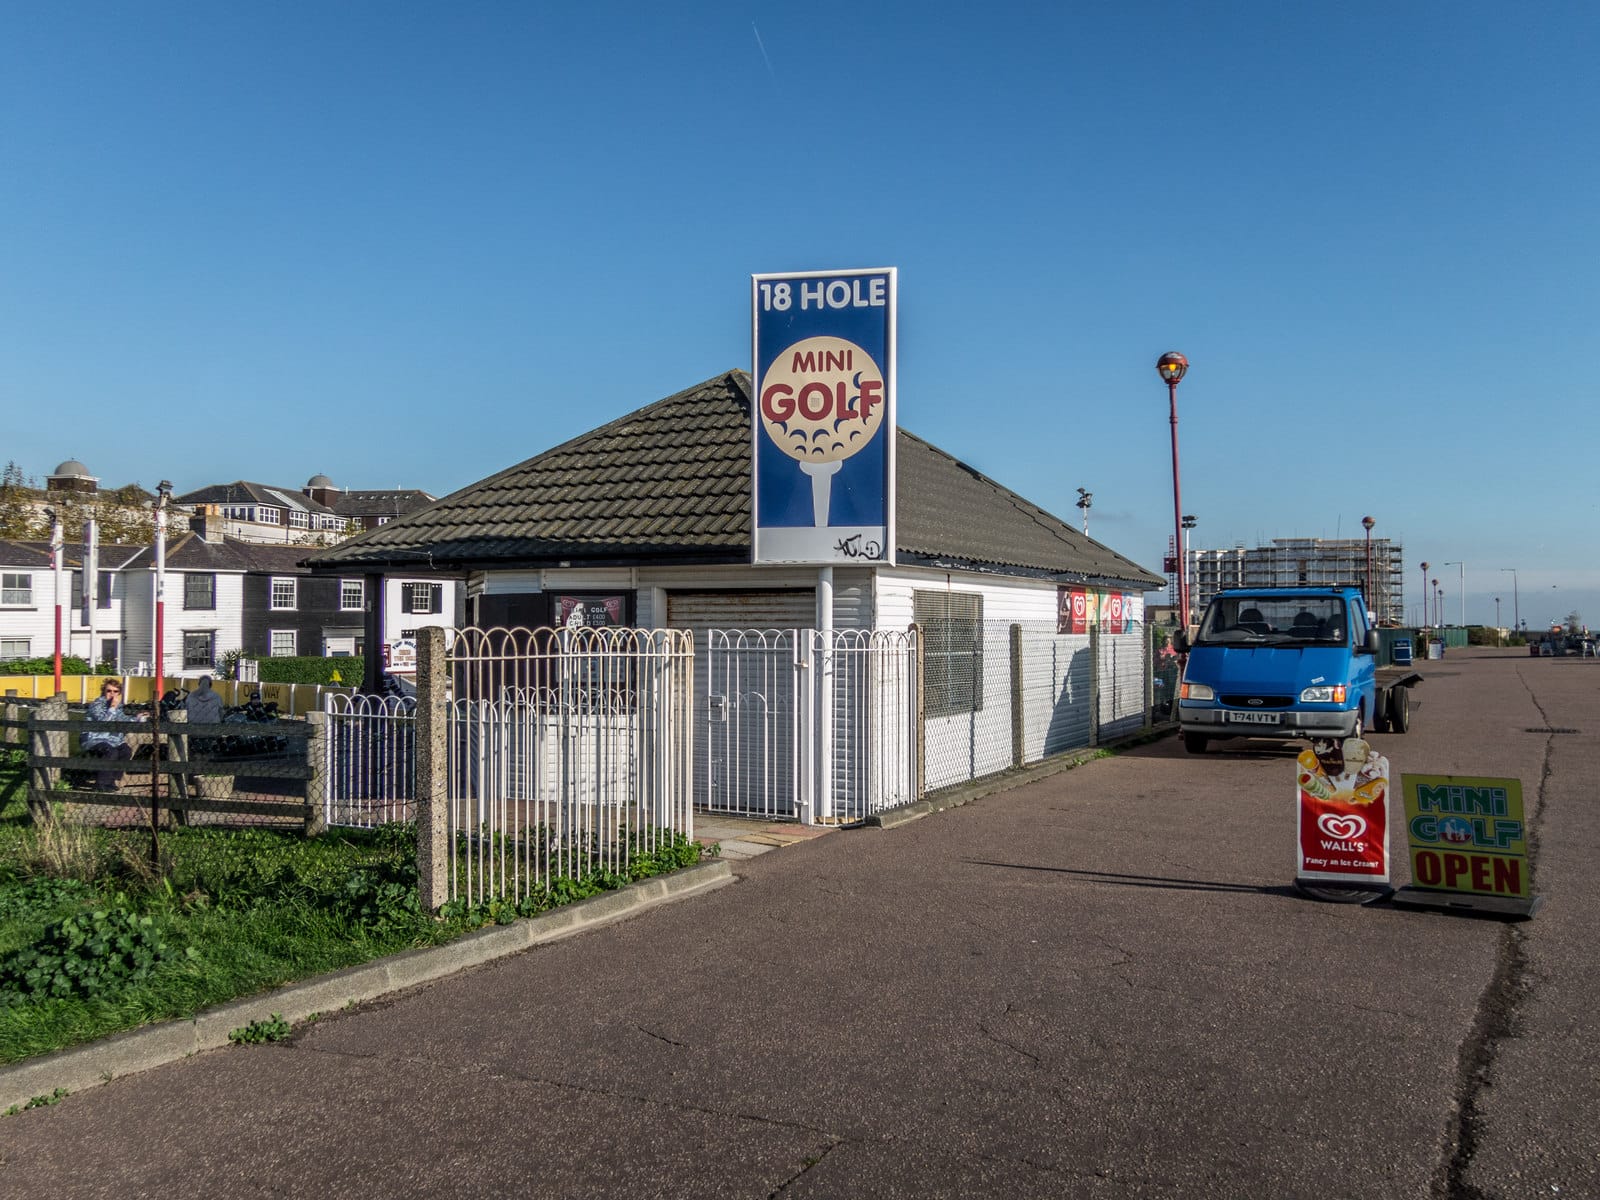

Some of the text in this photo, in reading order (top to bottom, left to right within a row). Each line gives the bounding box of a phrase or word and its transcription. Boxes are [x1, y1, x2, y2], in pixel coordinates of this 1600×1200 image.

[760, 278, 886, 311] 18 HOLE
[791, 350, 852, 373] MINI
[762, 380, 882, 422] GOLF
[1257, 713, 1278, 723] VTW
[1320, 840, 1364, 853] WALL'S
[1415, 851, 1521, 894] OPEN
